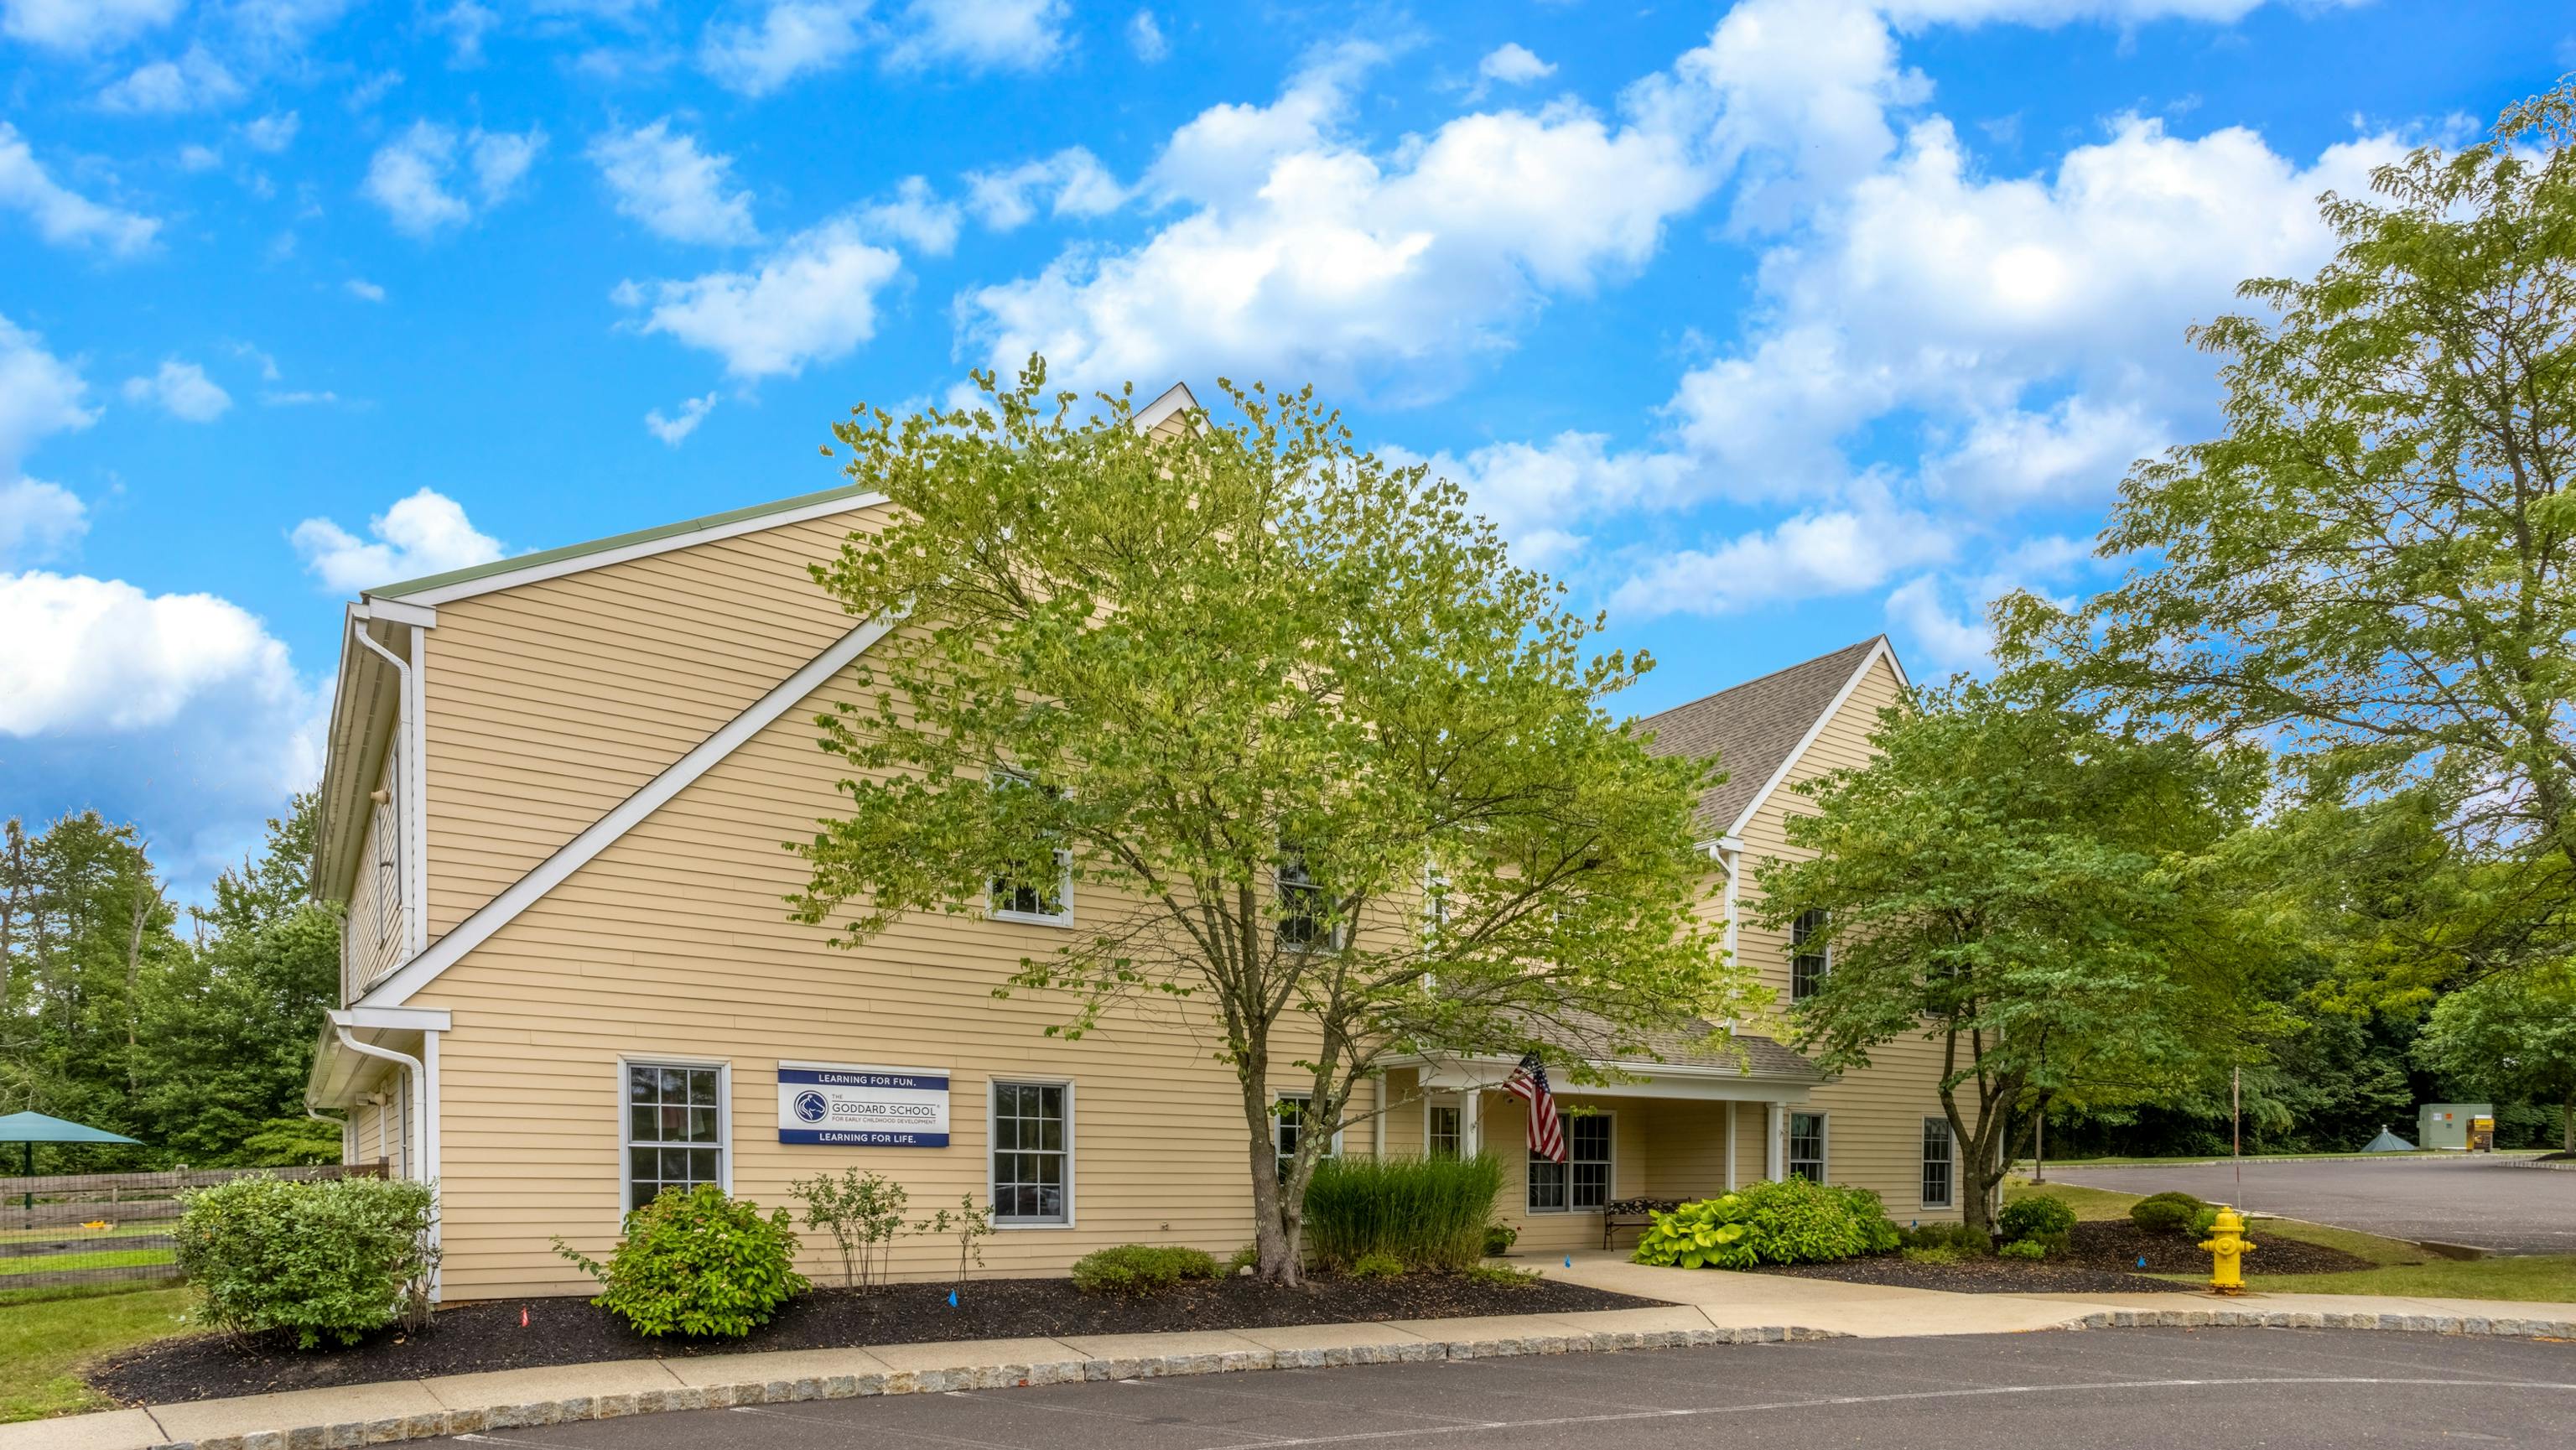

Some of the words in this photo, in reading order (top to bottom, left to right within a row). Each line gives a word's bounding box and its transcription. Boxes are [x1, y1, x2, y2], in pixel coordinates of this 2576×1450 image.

[818, 1074, 867, 1084] LEARNING
[870, 1077, 891, 1085] FOR
[893, 1078, 917, 1087] FUN.
[832, 1104, 886, 1114] GODDARD
[890, 1105, 937, 1115] SCHOOL
[819, 1133, 868, 1142] LEARNING
[894, 1135, 917, 1143] LIFE.
